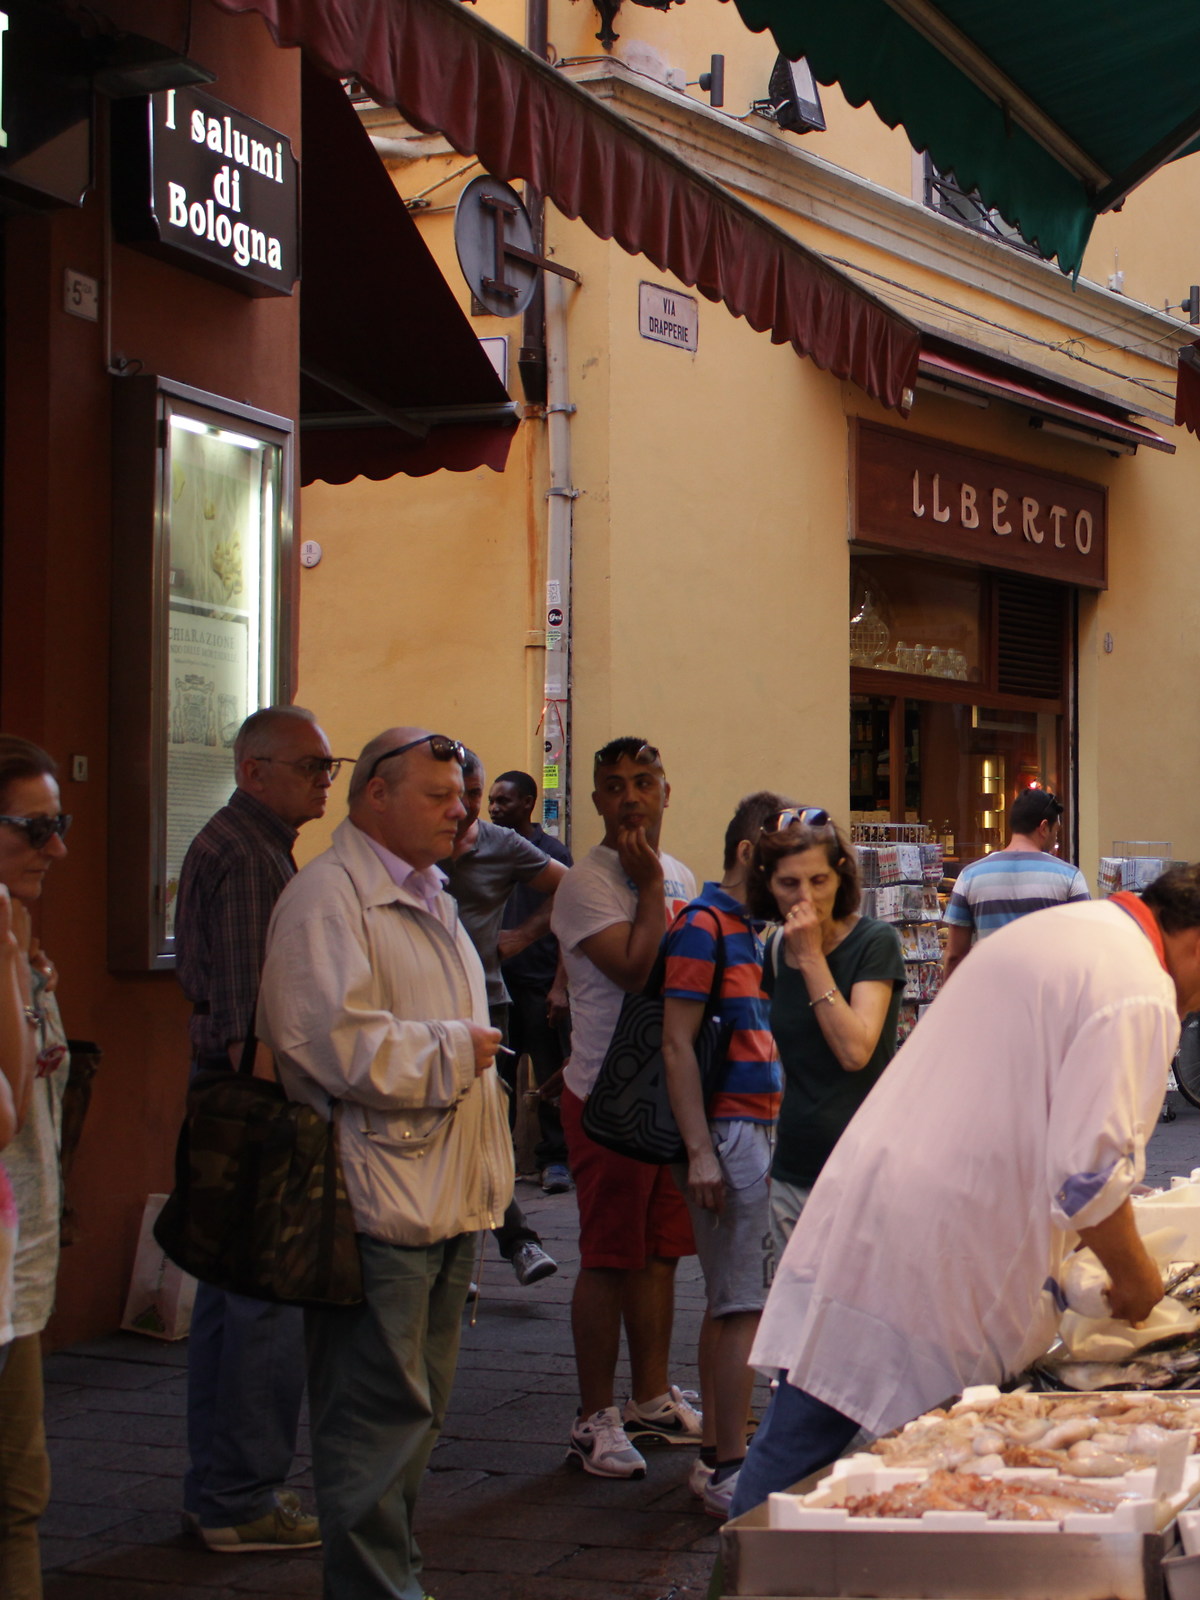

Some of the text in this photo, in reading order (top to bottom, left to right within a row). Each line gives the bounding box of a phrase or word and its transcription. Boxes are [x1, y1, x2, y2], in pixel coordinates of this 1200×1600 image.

[165, 88, 284, 184] I salumi
[213, 165, 241, 213] di
[168, 181, 283, 271] Bologna
[649, 315, 689, 343] DRAPPERIE
[663, 297, 676, 317] VIA
